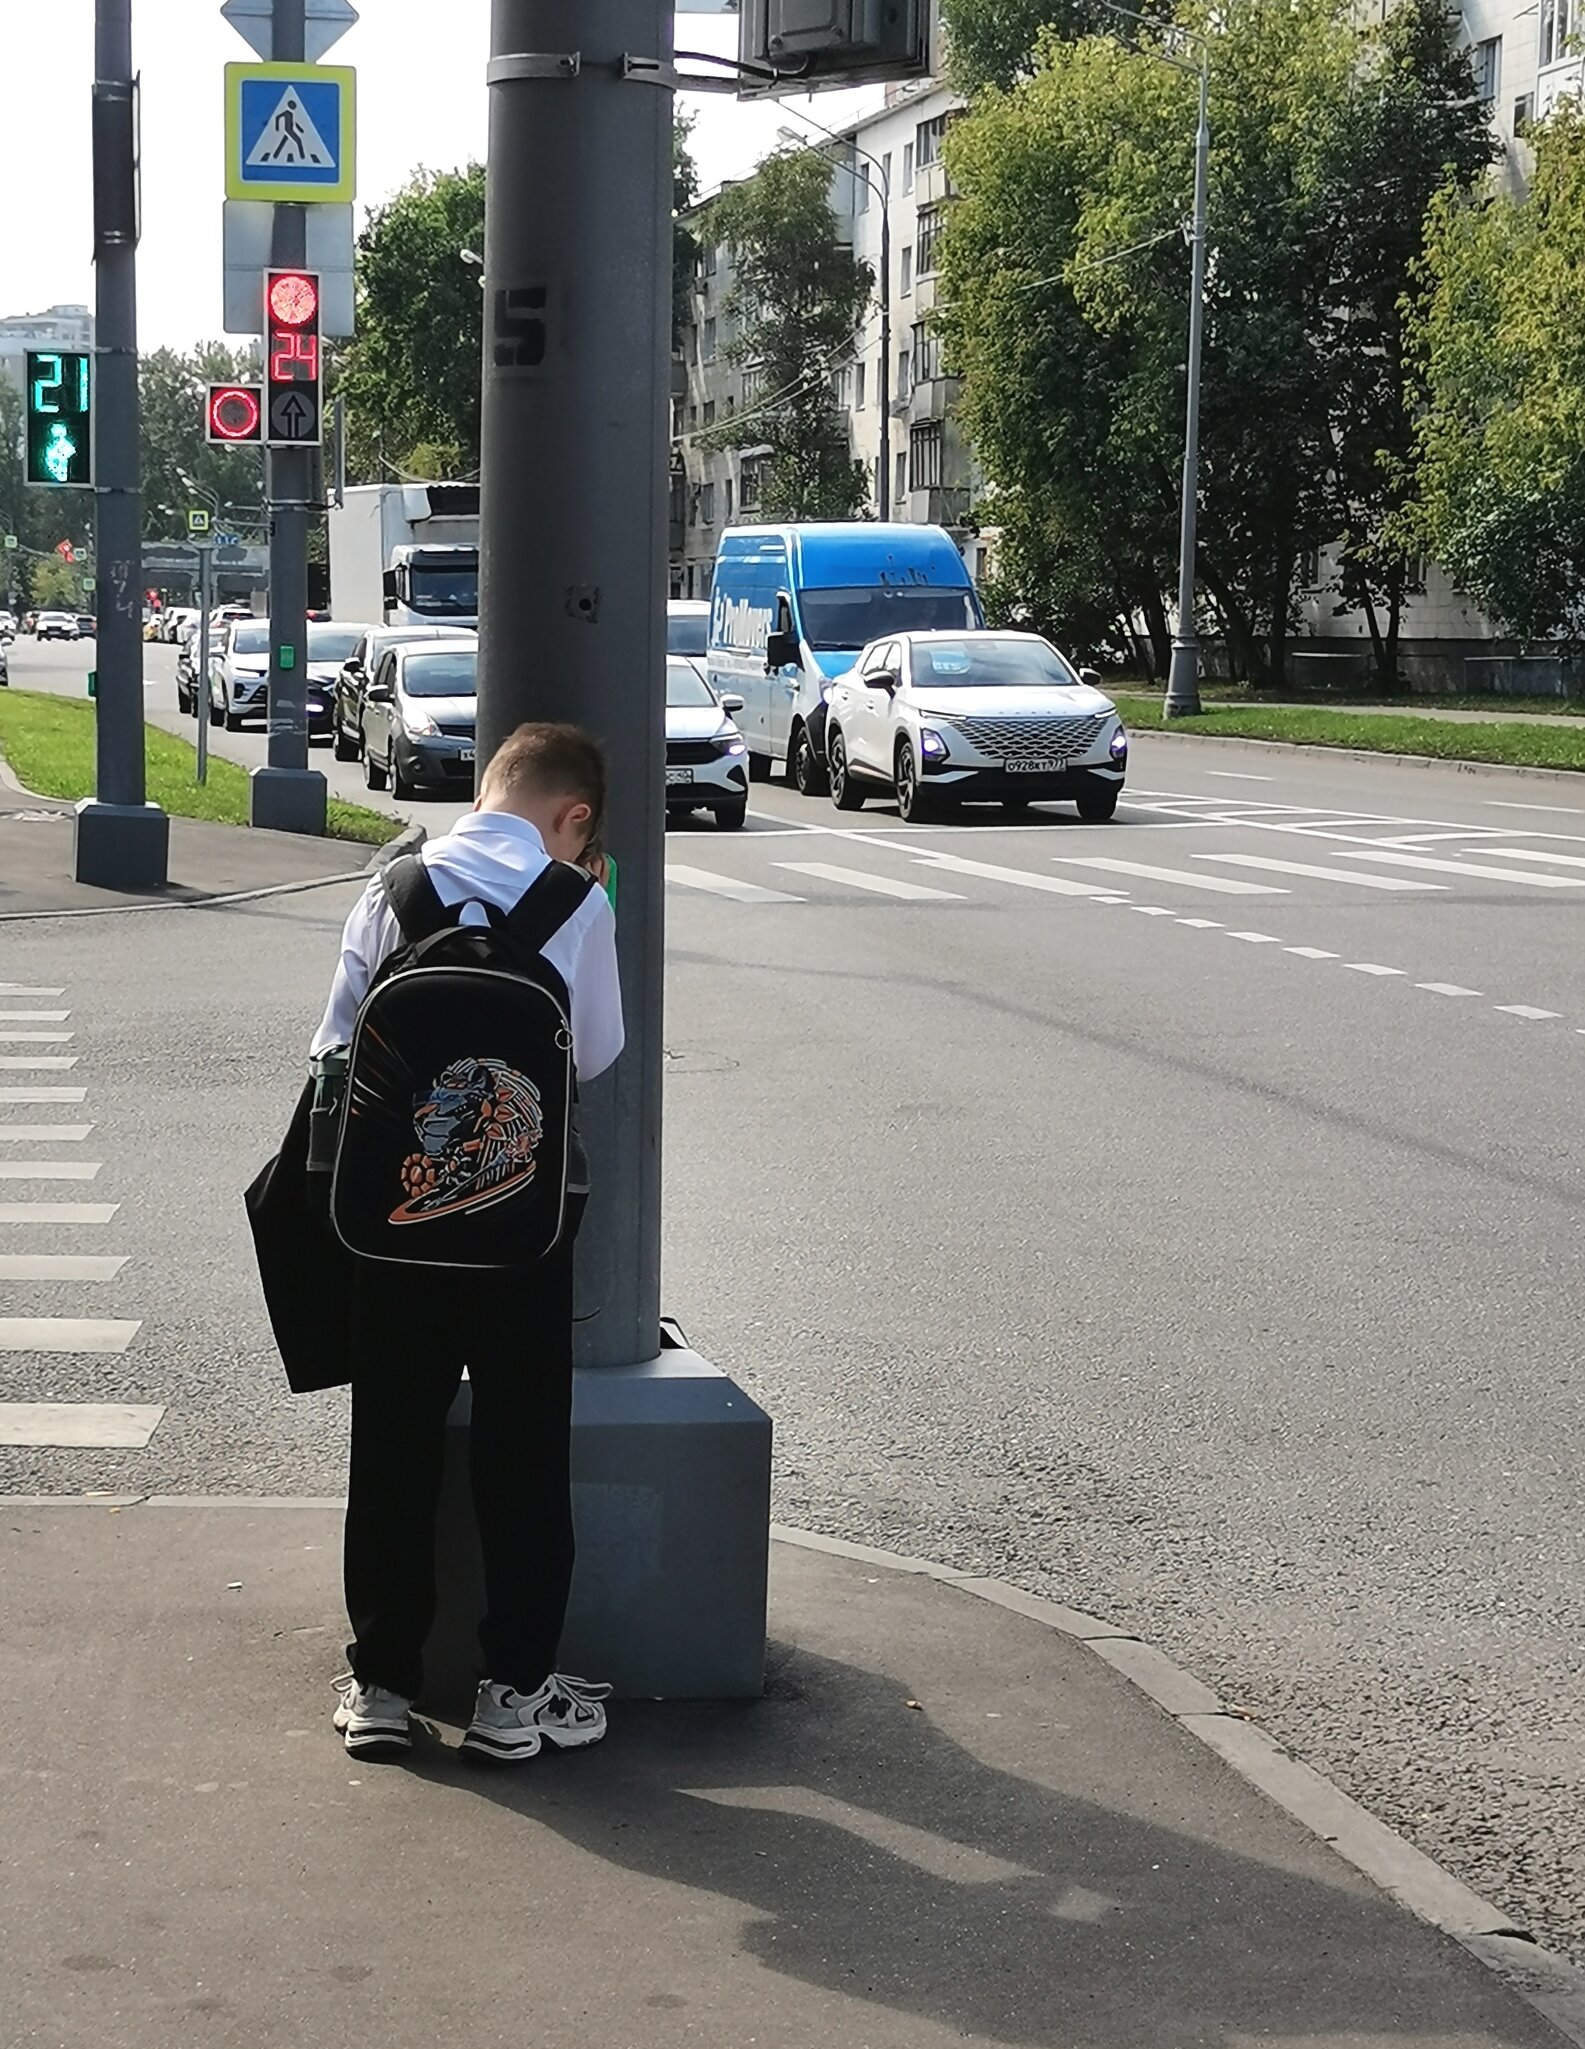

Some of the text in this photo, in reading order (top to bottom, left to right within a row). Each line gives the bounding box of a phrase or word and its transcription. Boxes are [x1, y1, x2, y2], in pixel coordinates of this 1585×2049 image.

[494, 286, 547, 367] 5
[33, 354, 89, 412] 21
[271, 332, 316, 382] 24
